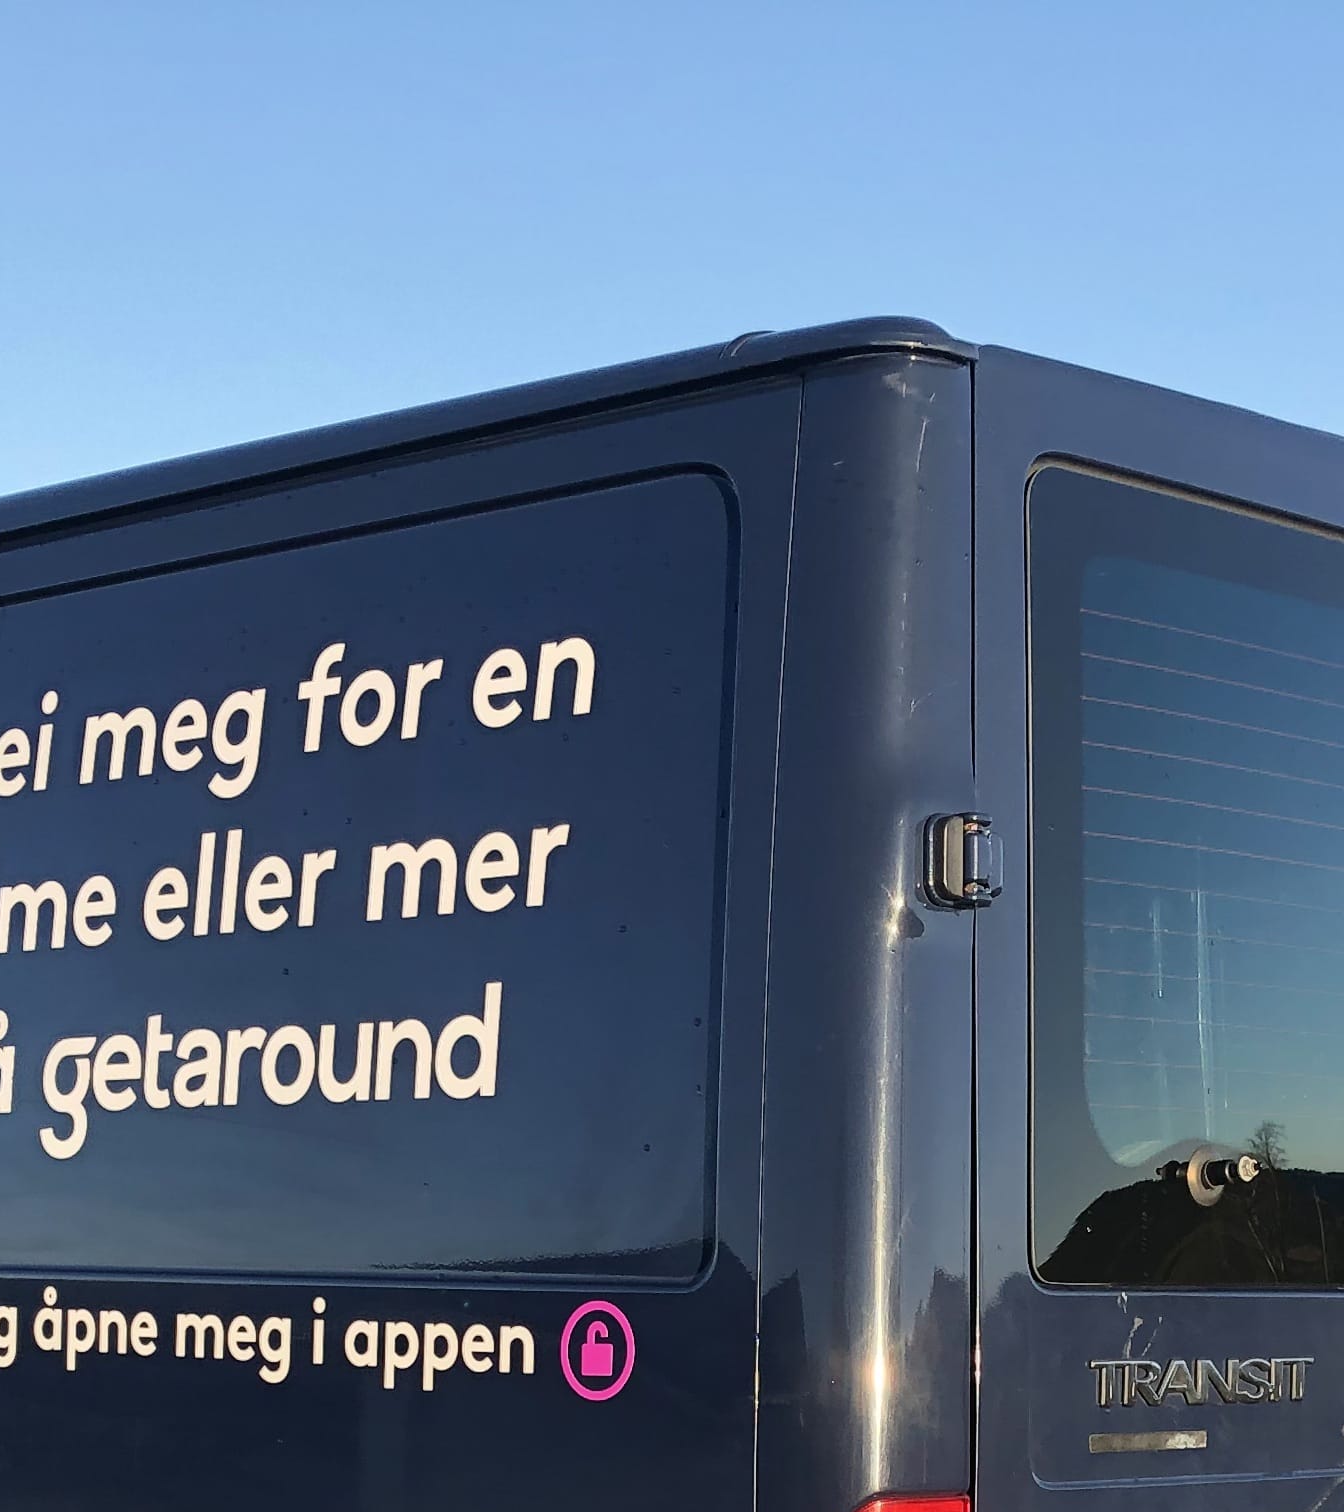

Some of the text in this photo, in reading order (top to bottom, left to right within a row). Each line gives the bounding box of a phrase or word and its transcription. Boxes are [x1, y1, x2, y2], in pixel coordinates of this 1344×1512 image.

[79, 686, 267, 799] meg
[297, 642, 444, 753] for
[472, 636, 595, 728] en
[143, 828, 337, 941] eller
[366, 823, 571, 922] mer
[39, 981, 503, 1160] getaround
[33, 1285, 158, 1371] åpne
[175, 1313, 292, 1384] meg
[311, 1297, 327, 1366] i
[343, 1319, 535, 1392] appen
[1089, 1357, 1315, 1407] TRANSIT
